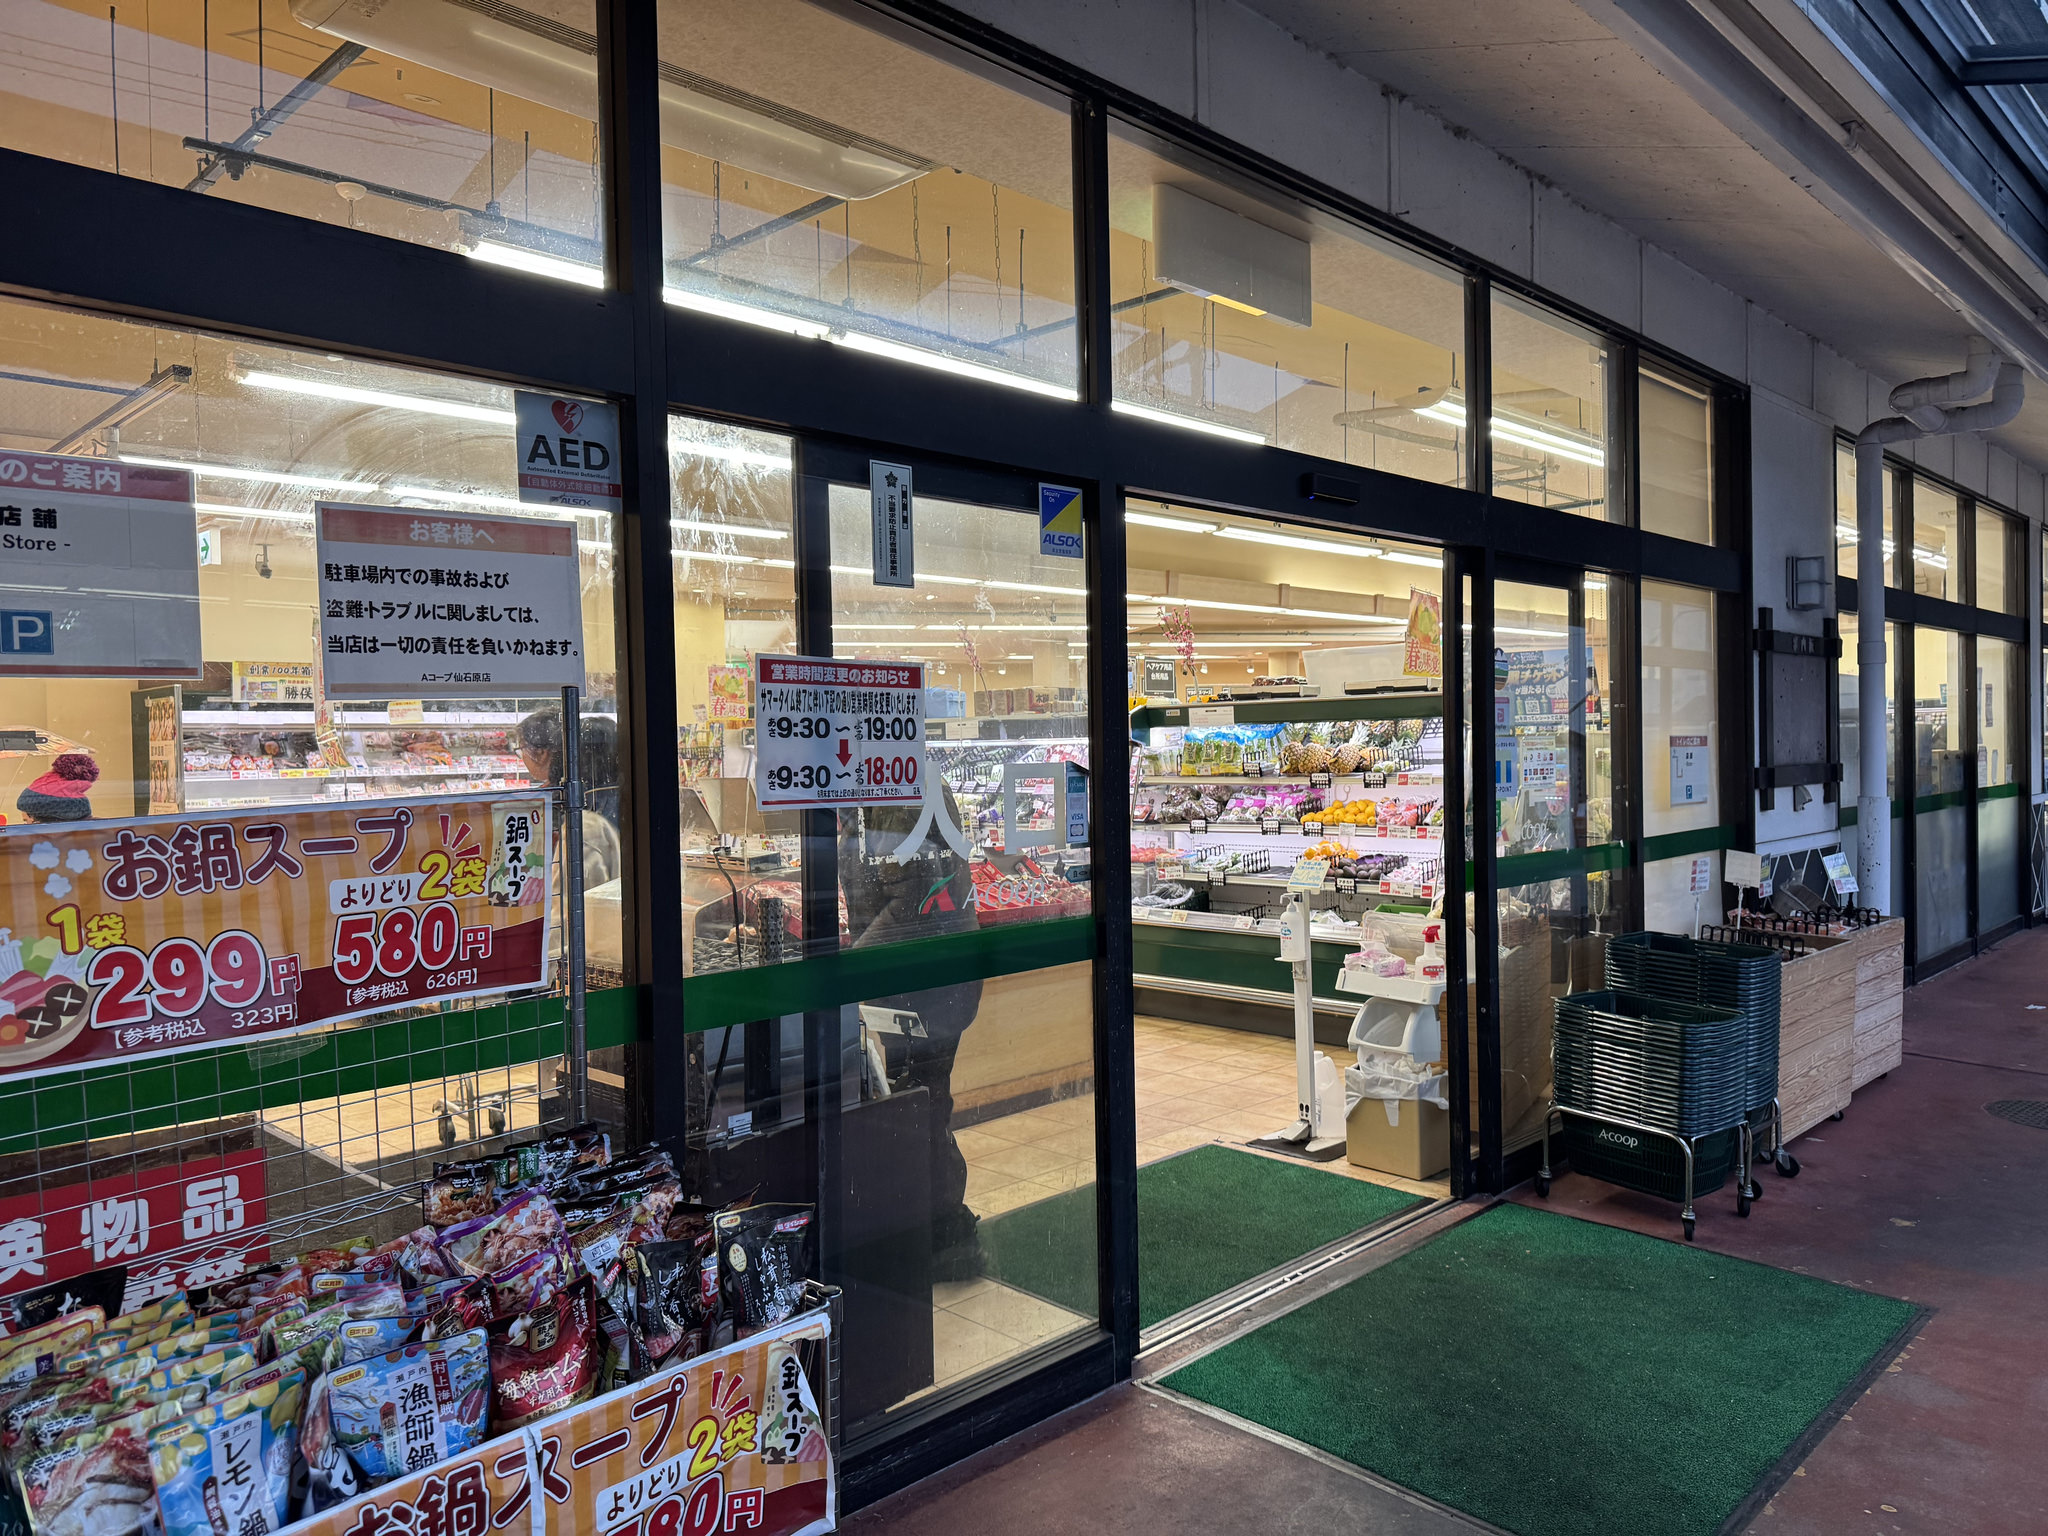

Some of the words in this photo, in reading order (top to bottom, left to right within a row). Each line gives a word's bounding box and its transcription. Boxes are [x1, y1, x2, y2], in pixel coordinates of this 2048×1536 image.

[527, 434, 610, 471] AED
[527, 466, 556, 474] Automated
[0, 458, 122, 493] のご案内
[3, 534, 57, 551] Store
[409, 520, 496, 546] お客様へ
[1043, 533, 1081, 549] ALSOK
[324, 563, 510, 590] 駐車場内での事故および
[12, 615, 44, 650] P
[328, 635, 579, 657] 当店は一切の責任を負いかねます。
[421, 672, 492, 683] Aコープ仙石原店
[770, 663, 910, 685] 営業時間変更のお知らせ
[768, 718, 777, 738] あさ
[776, 716, 831, 739] 9:30
[854, 719, 864, 741] よる
[864, 717, 917, 741] 19:00
[768, 770, 777, 791] あさ
[777, 765, 831, 789] 9:30
[855, 762, 864, 785] よる
[865, 756, 917, 786] 18:00
[1071, 813, 1083, 821] VISA
[103, 807, 415, 900] お鍋スープ
[505, 815, 529, 898] 鍋スープ
[340, 879, 413, 908] よりどり
[418, 852, 487, 901] 2袋
[48, 903, 127, 956] 1袋
[333, 902, 494, 985] 580円
[88, 929, 301, 1030] 299円
[344, 982, 409, 1007] 【参考税込
[426, 967, 479, 990] 626円】
[113, 1018, 206, 1050] 【参考税込
[394, 1366, 428, 1384] 瀬戸内
[432, 1361, 454, 1418] 村上海賊
[219, 1419, 253, 1441] 瀬戸内
[398, 1382, 439, 1471] 漁師鍋
[606, 1460, 682, 1523] よりどり
[686, 1404, 760, 1482] 2袋
[604, 1472, 765, 1536] 80円
